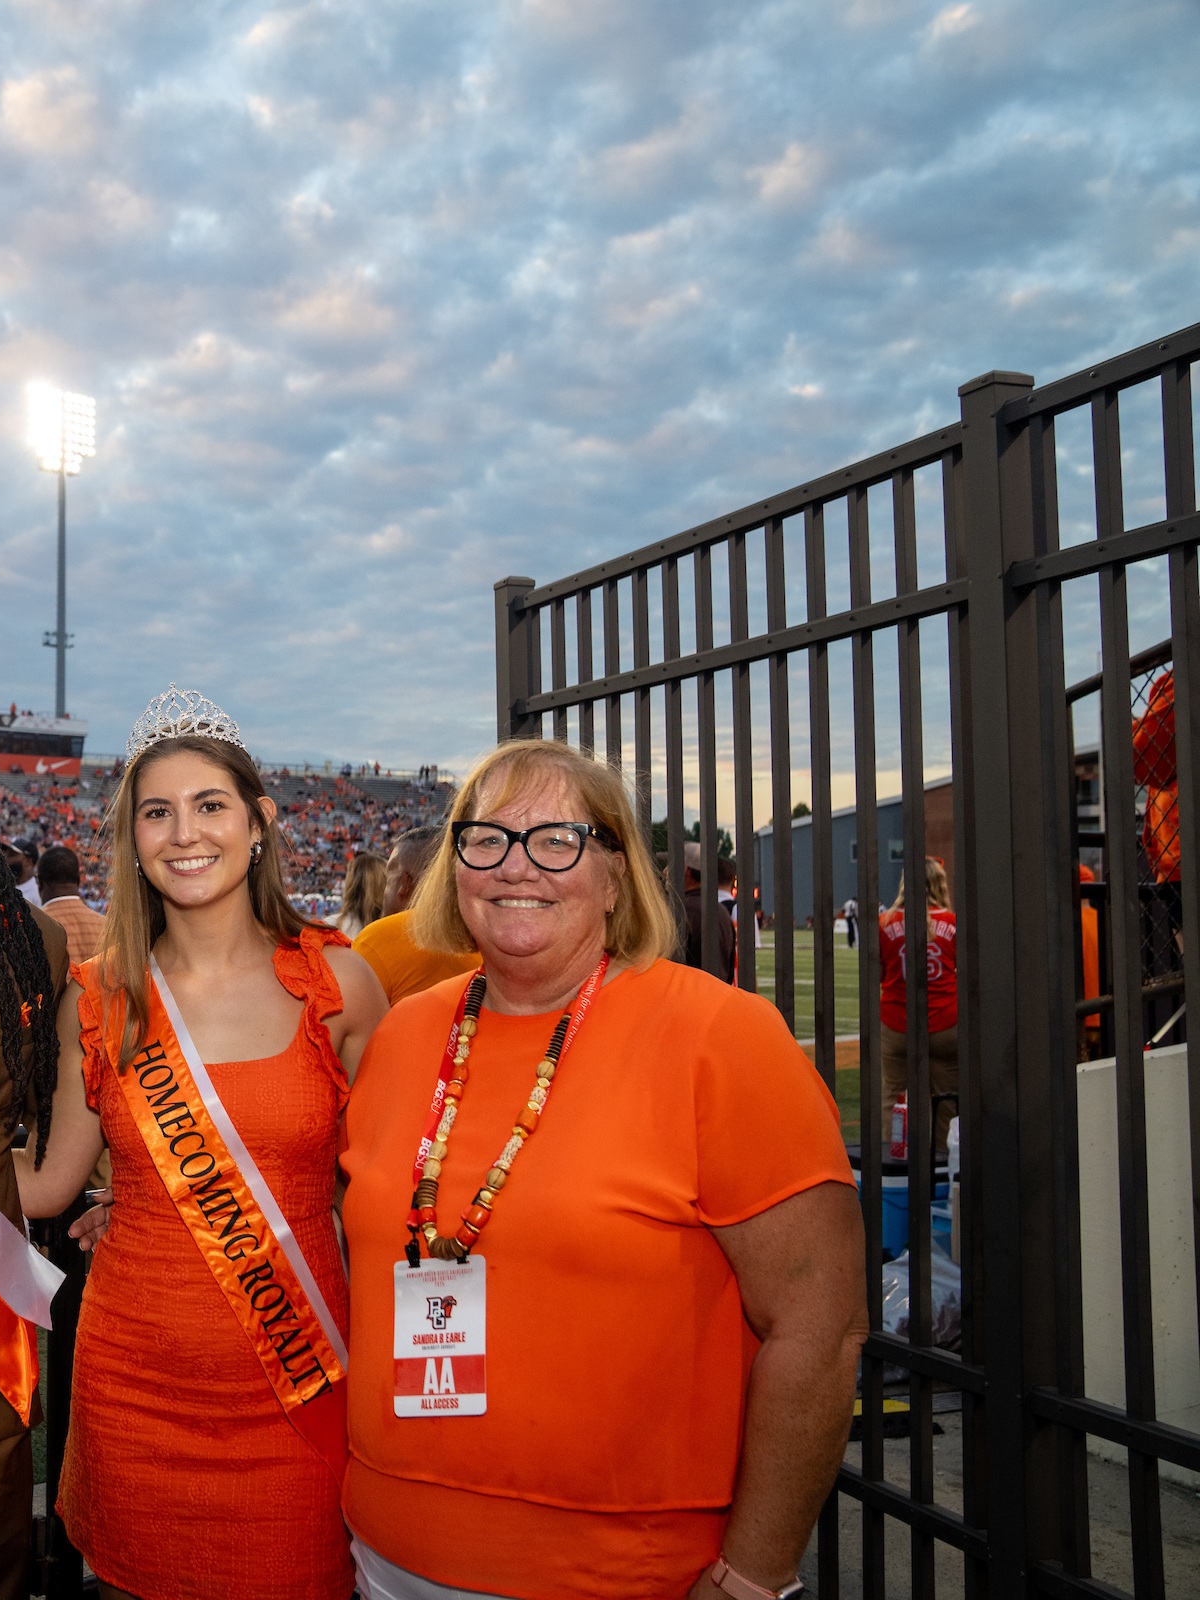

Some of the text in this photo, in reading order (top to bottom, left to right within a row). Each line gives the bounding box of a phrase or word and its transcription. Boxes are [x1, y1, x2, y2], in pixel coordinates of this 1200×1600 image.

[576, 996, 591, 1013] for
[446, 1022, 459, 1057] BGSU
[430, 1078, 447, 1115] BGSU
[414, 1136, 433, 1170] BGSU
[133, 1039, 333, 1406] HOMECOMING ROYALTY
[412, 1333, 438, 1345] SANDRA
[445, 1331, 466, 1343] EARLE
[423, 1357, 456, 1394] AA
[421, 1397, 459, 1410] ALL ACCESS
